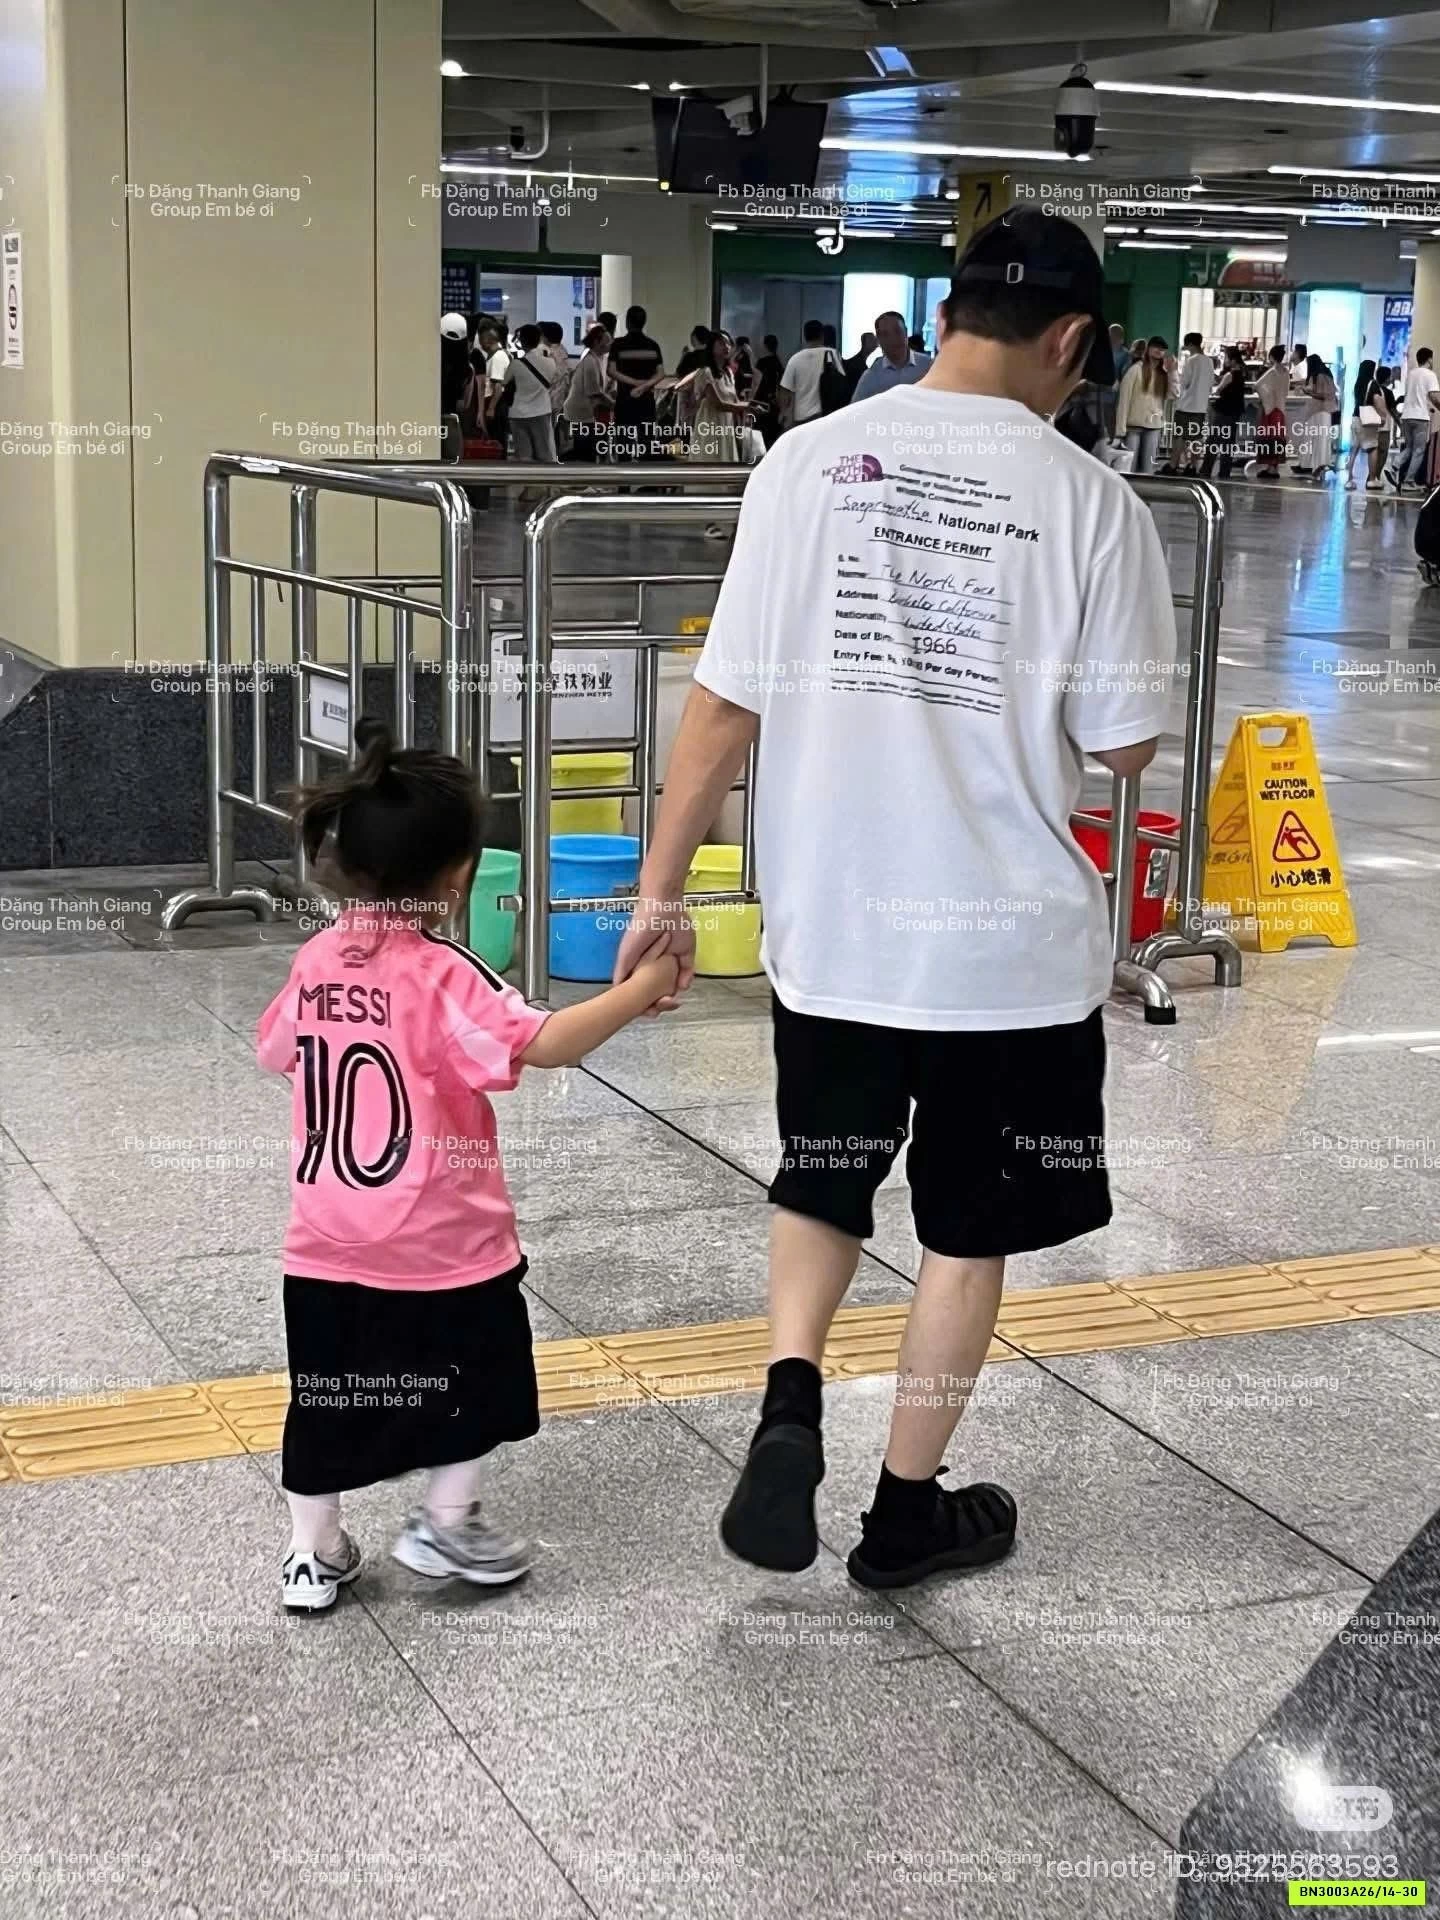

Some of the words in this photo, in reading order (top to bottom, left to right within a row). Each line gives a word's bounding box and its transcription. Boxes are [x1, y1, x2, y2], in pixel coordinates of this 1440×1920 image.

[839, 455, 862, 465] THE
[937, 512, 1001, 536] National
[1004, 523, 1041, 543] Park
[873, 526, 942, 550] ENTRANCE
[943, 540, 993, 558] PERMIT
[909, 569, 955, 592] North
[963, 578, 997, 595] Face
[834, 629, 858, 641] Date
[860, 631, 872, 642] of
[833, 650, 861, 663] Entry
[924, 662, 943, 673] Per
[944, 666, 963, 680] day
[1259, 790, 1283, 801] WET
[1282, 789, 1316, 801] FLOOR
[1263, 778, 1308, 790] CAUTION
[1270, 867, 1332, 888] 小心地滑
[297, 983, 392, 1029] MESSI
[296, 1034, 413, 1191] 10
